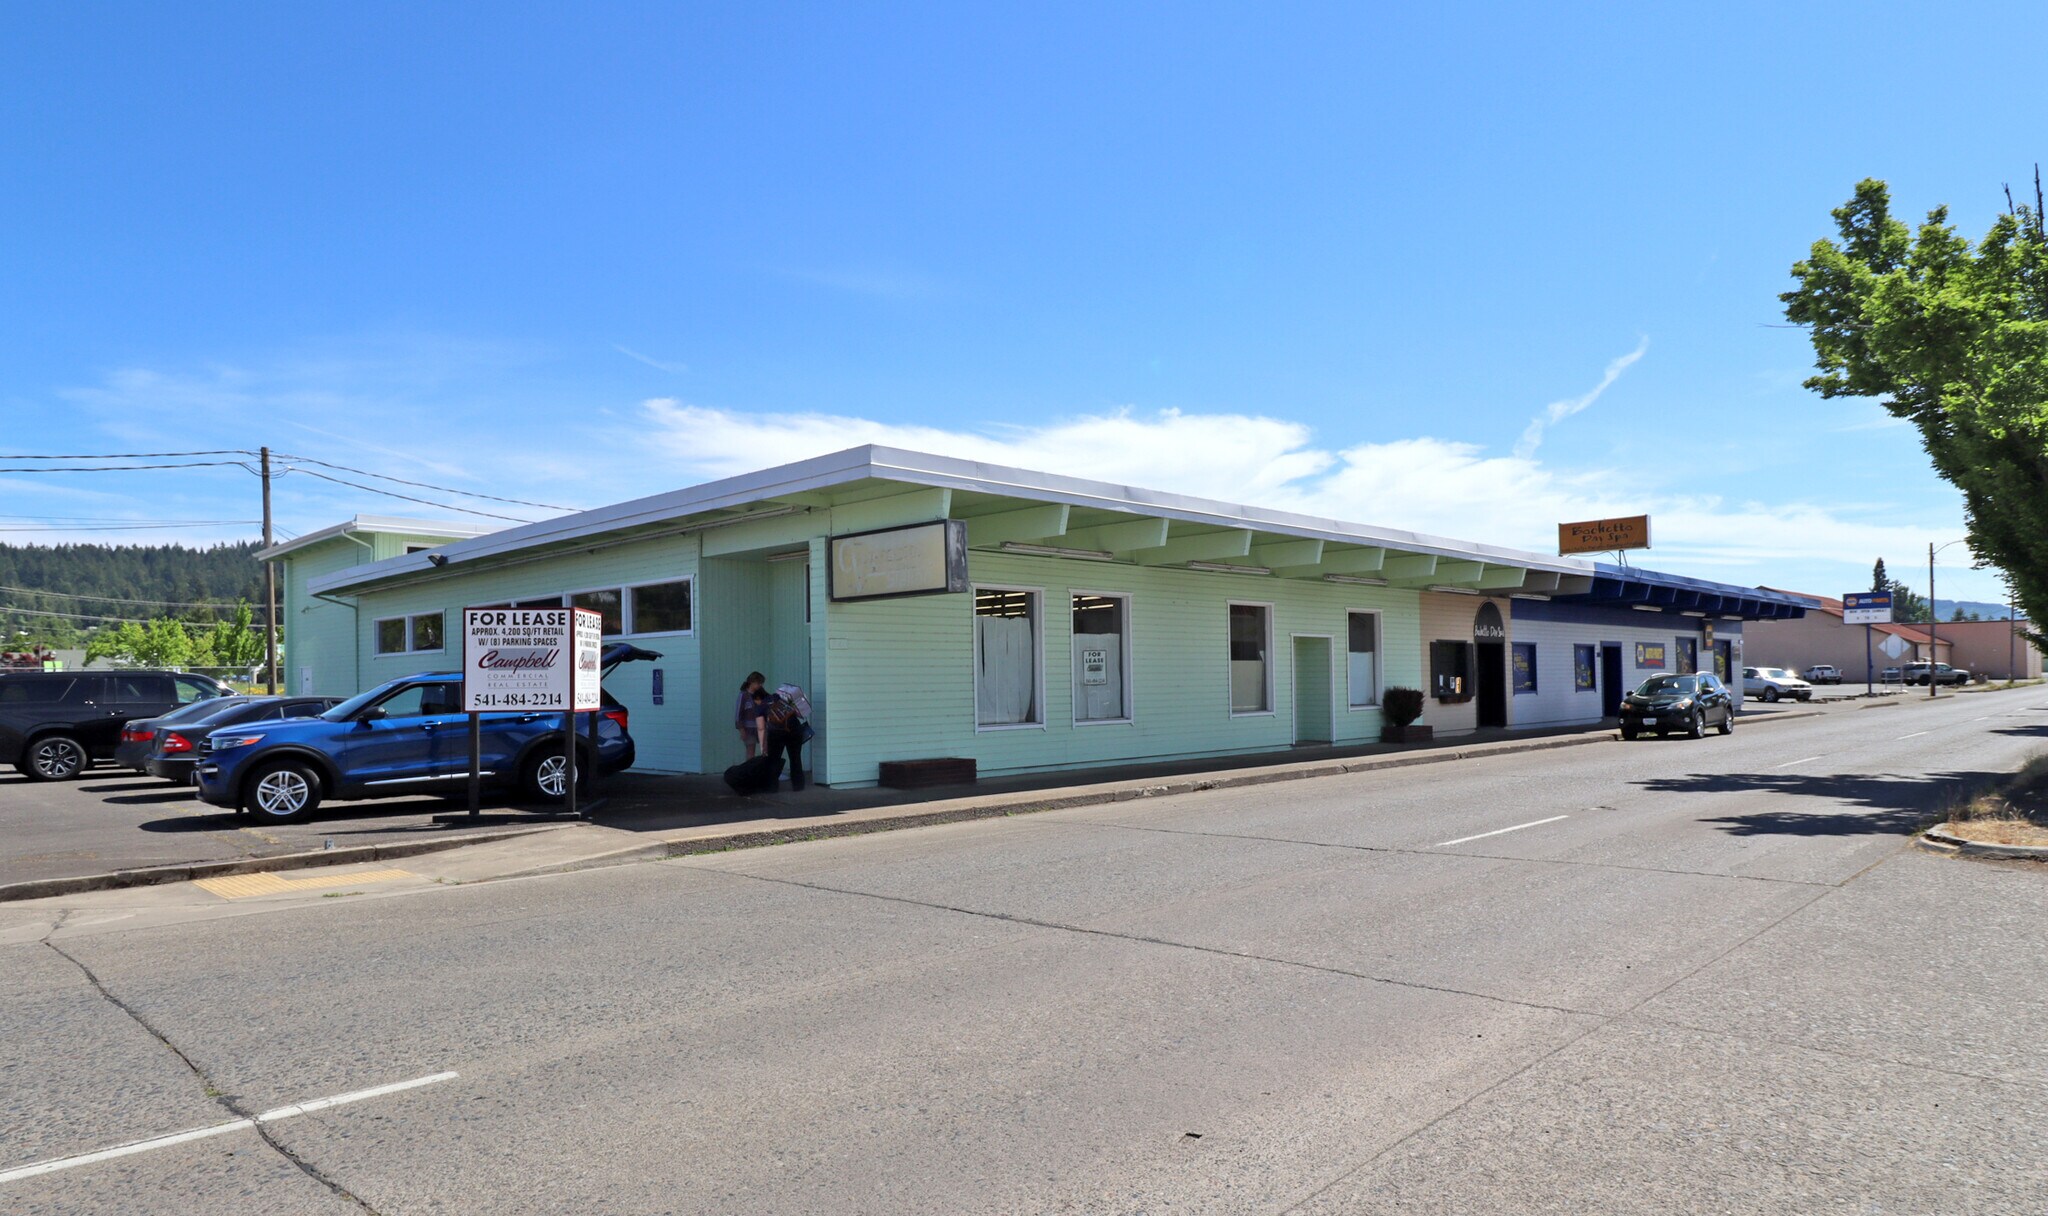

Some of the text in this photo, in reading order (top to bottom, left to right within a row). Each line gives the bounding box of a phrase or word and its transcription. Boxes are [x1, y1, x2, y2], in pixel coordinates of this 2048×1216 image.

[1608, 532, 1629, 542] Spa
[470, 612, 566, 626] FOR LEASE
[575, 612, 601, 631] FOR LEASE
[471, 627, 564, 638] APPROX. 4,200 SQ/FT RETAIL
[478, 637, 558, 647] W/ (8) PARKING SPACES
[478, 648, 560, 674] Campbell
[474, 693, 562, 706] 541-484-2214
